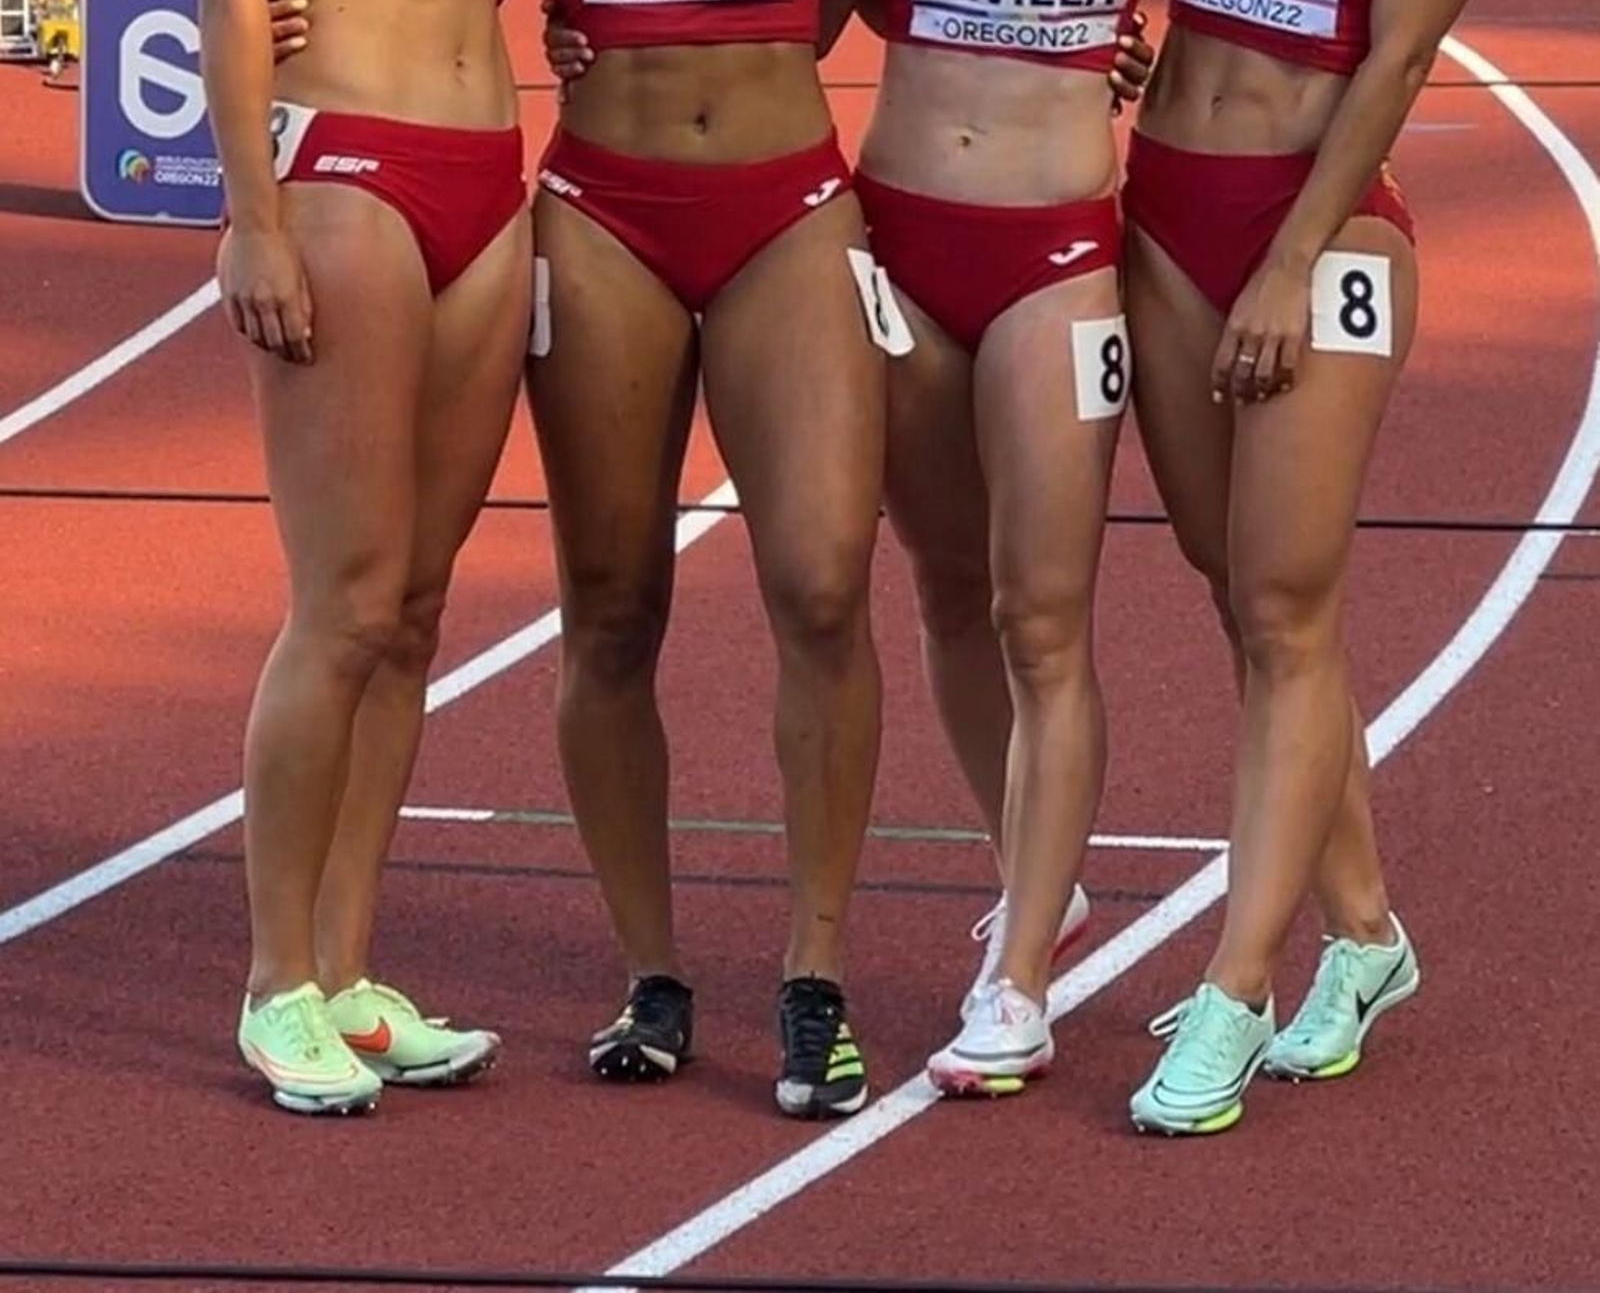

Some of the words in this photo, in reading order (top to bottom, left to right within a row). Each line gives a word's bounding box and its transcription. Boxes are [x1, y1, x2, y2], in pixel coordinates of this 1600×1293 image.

[942, 18, 1089, 47] OREGON22
[118, 9, 208, 138] 6
[1338, 269, 1378, 340] 8
[1099, 333, 1125, 404] 8
